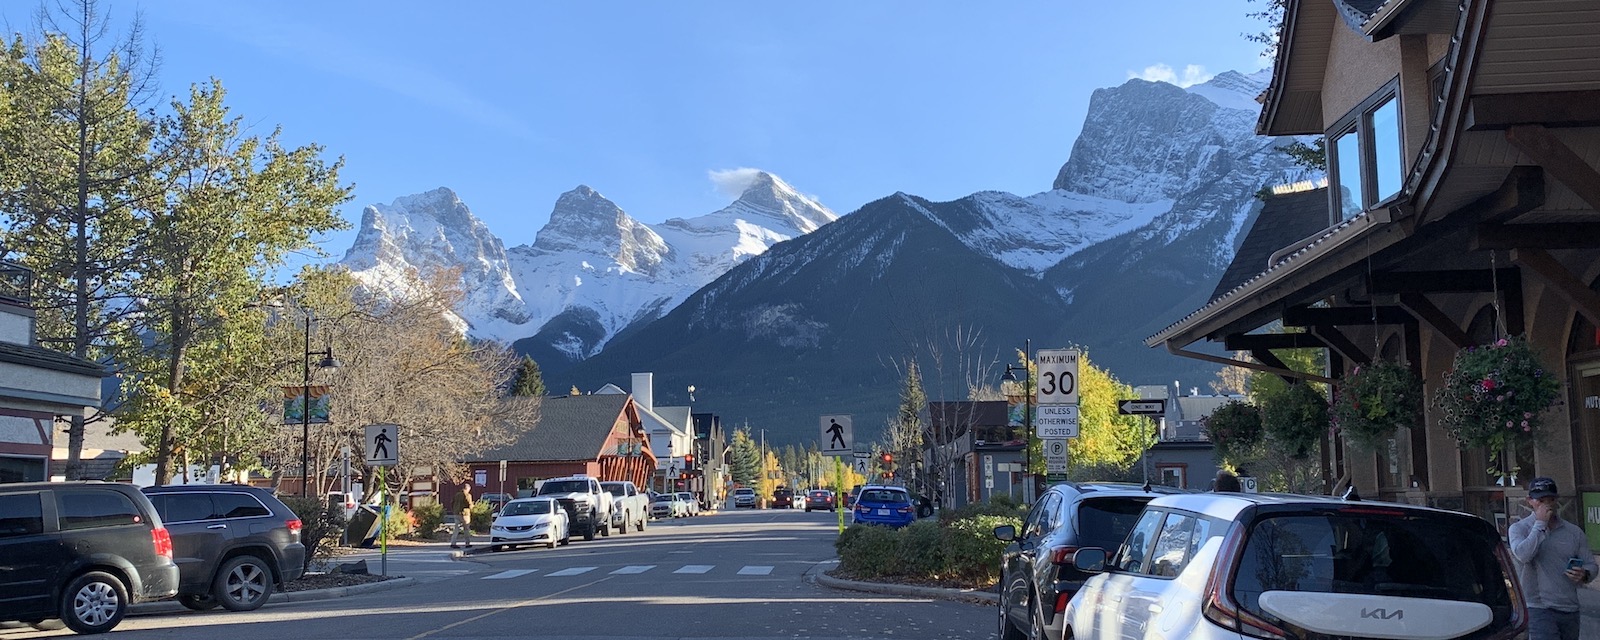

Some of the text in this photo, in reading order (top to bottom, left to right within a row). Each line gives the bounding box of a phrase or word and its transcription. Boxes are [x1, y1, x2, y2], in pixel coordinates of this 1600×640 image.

[1040, 356, 1076, 364] MAXIMUM
[1041, 371, 1074, 395] 30
[1054, 444, 1060, 452] P
